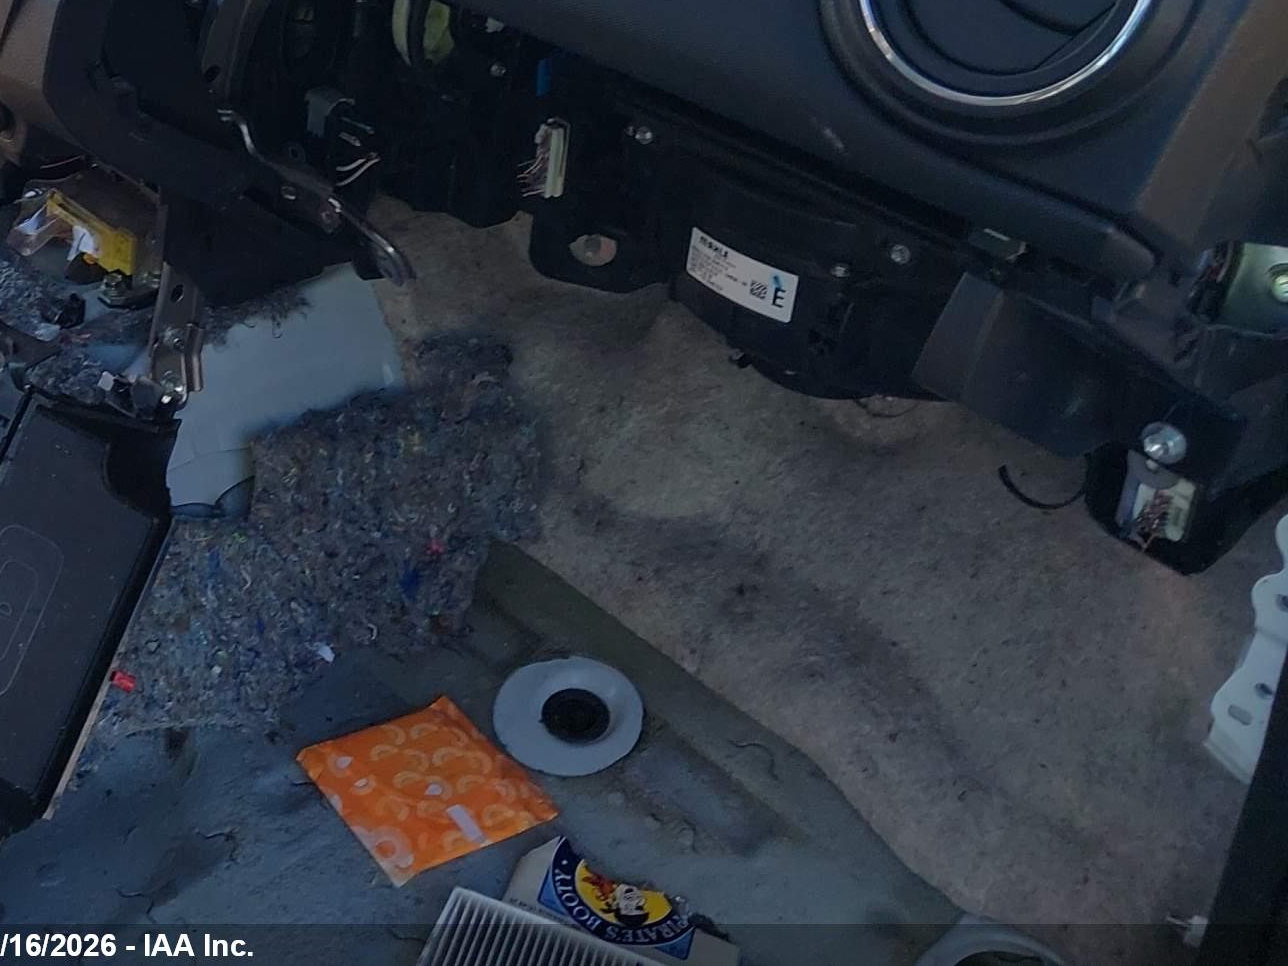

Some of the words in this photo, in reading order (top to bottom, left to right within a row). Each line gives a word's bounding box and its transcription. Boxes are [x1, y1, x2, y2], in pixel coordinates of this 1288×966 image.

[772, 287, 786, 308] E
[554, 868, 602, 931] BOOTY
[606, 914, 690, 943] PIRATE'S
